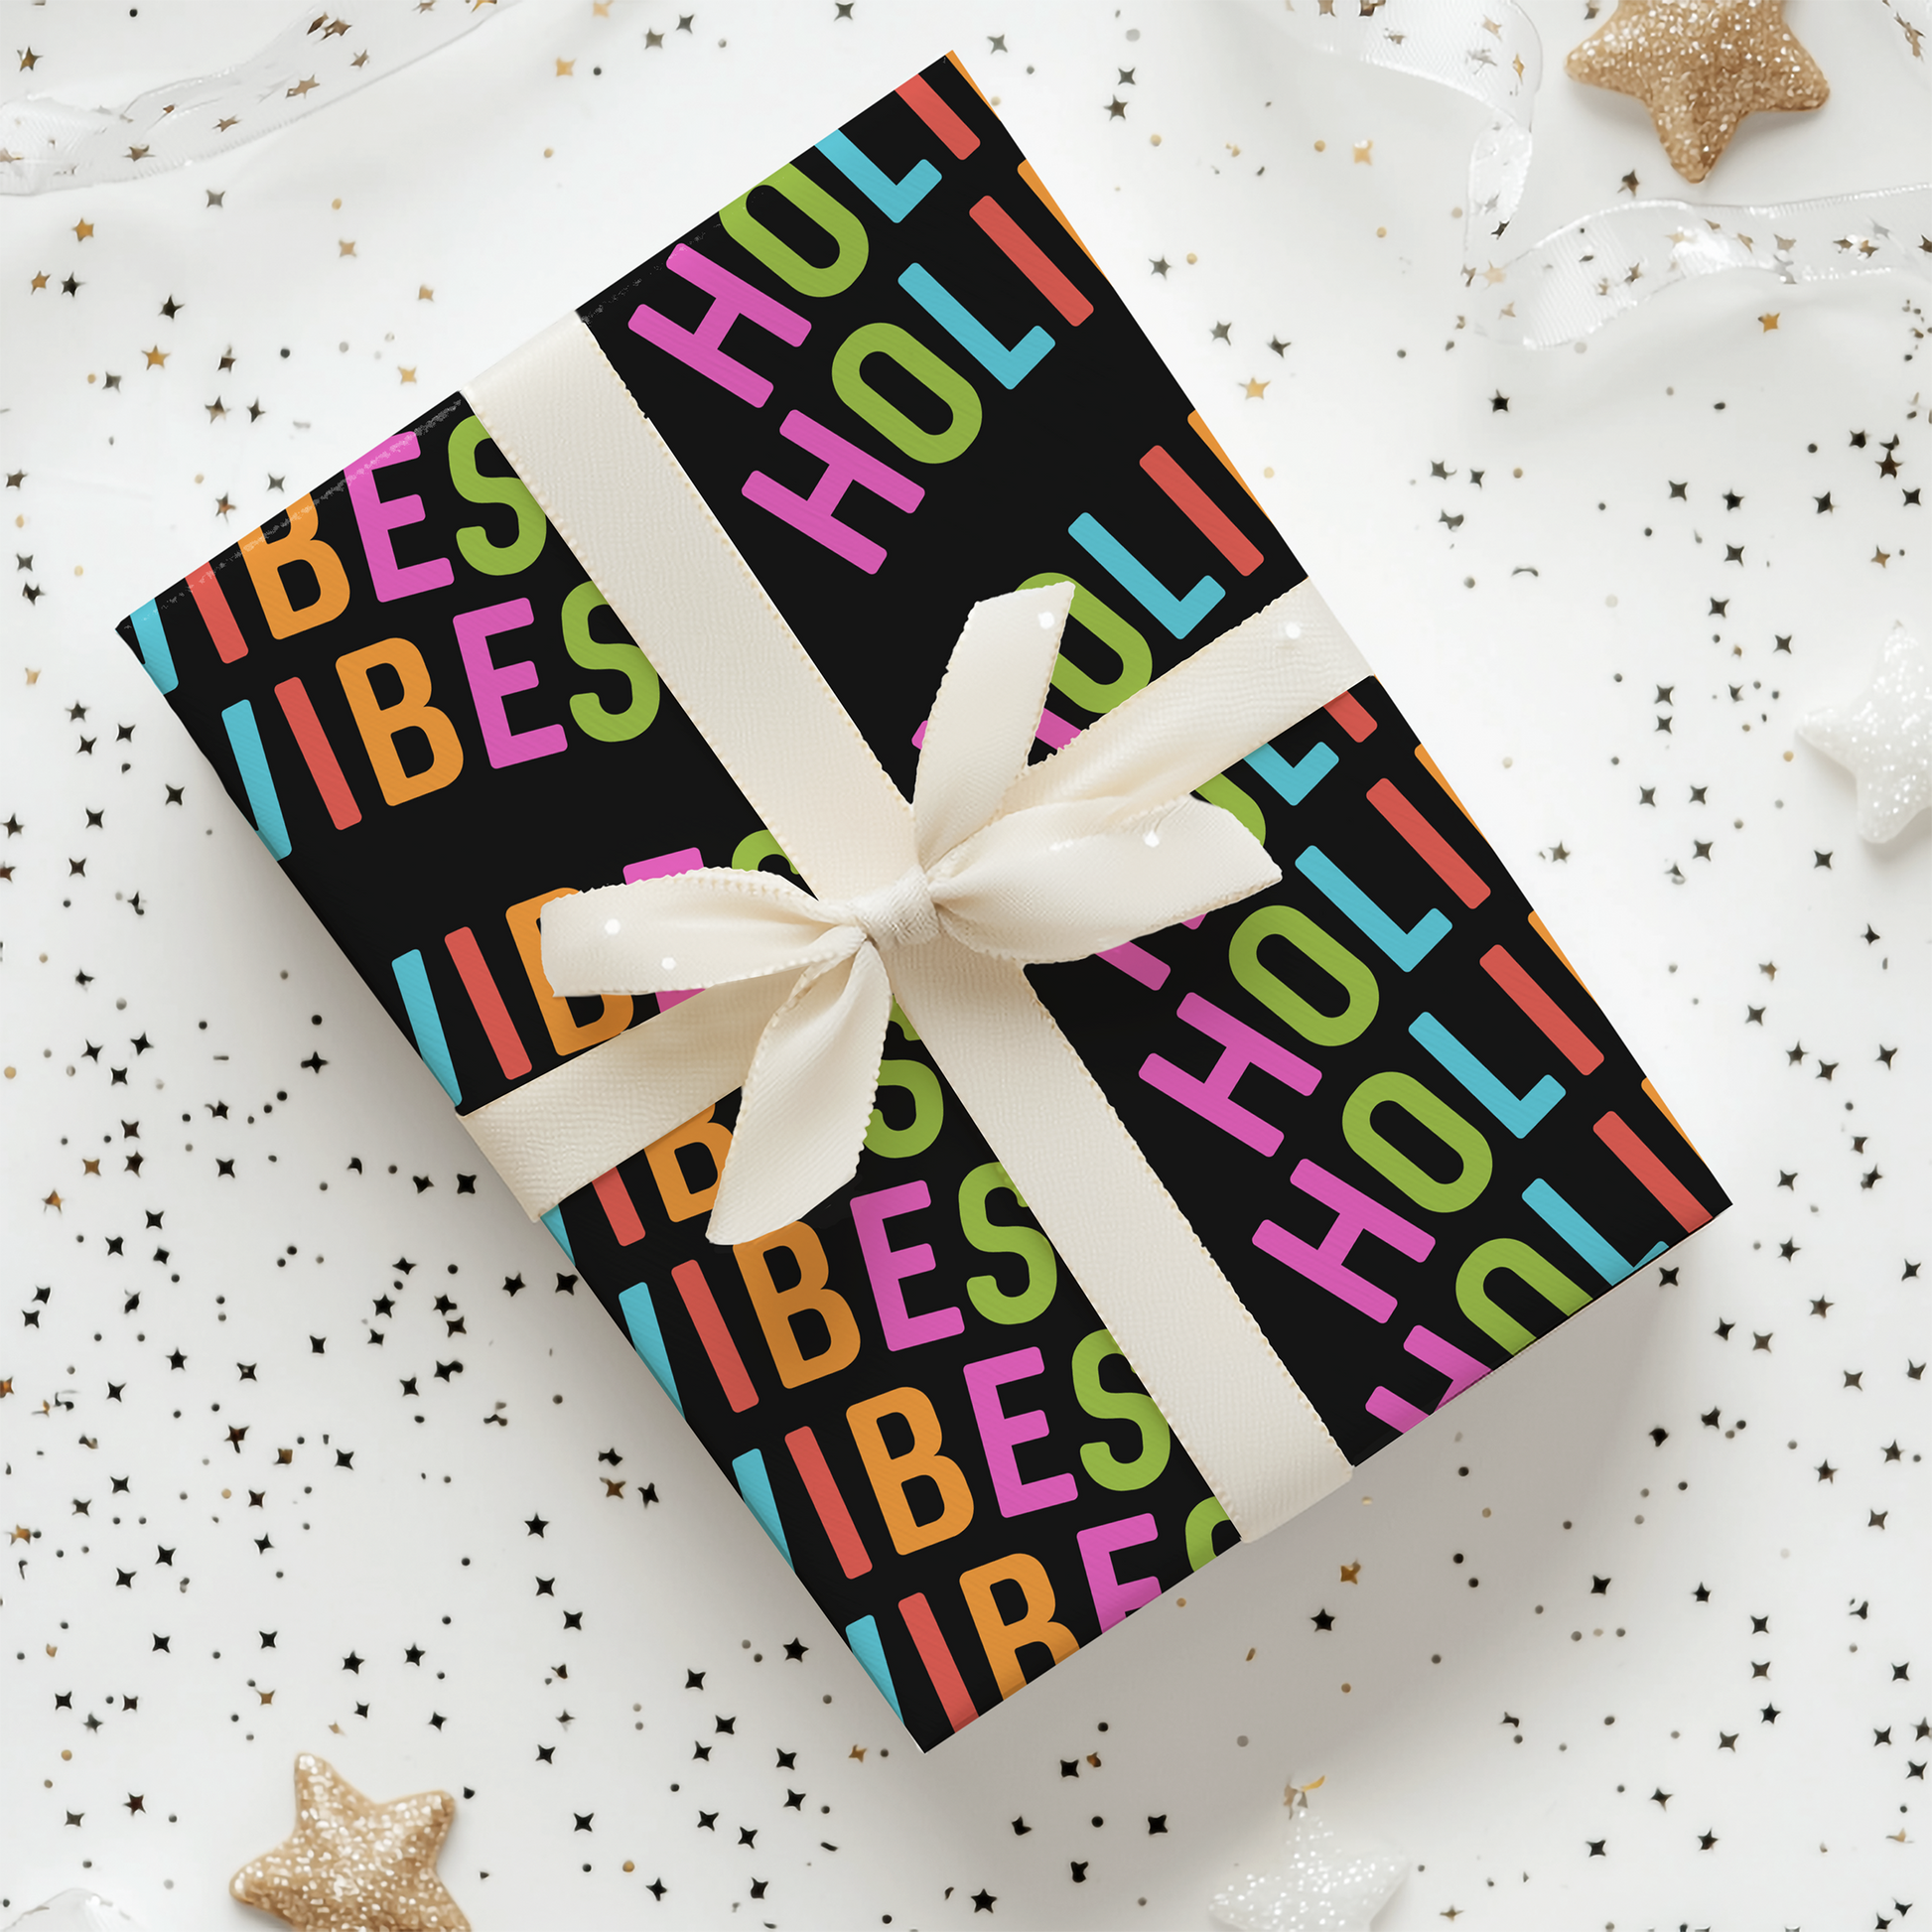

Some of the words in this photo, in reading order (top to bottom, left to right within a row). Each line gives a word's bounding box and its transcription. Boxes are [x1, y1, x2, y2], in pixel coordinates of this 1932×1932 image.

[627, 51, 1001, 409] HOLI
[741, 159, 1112, 575] HOLI
[911, 410, 1273, 752] OLI
[1139, 743, 1492, 1158] HOLI
[1251, 909, 1605, 1324] HOLI
[1364, 1077, 1714, 1435] OLI
